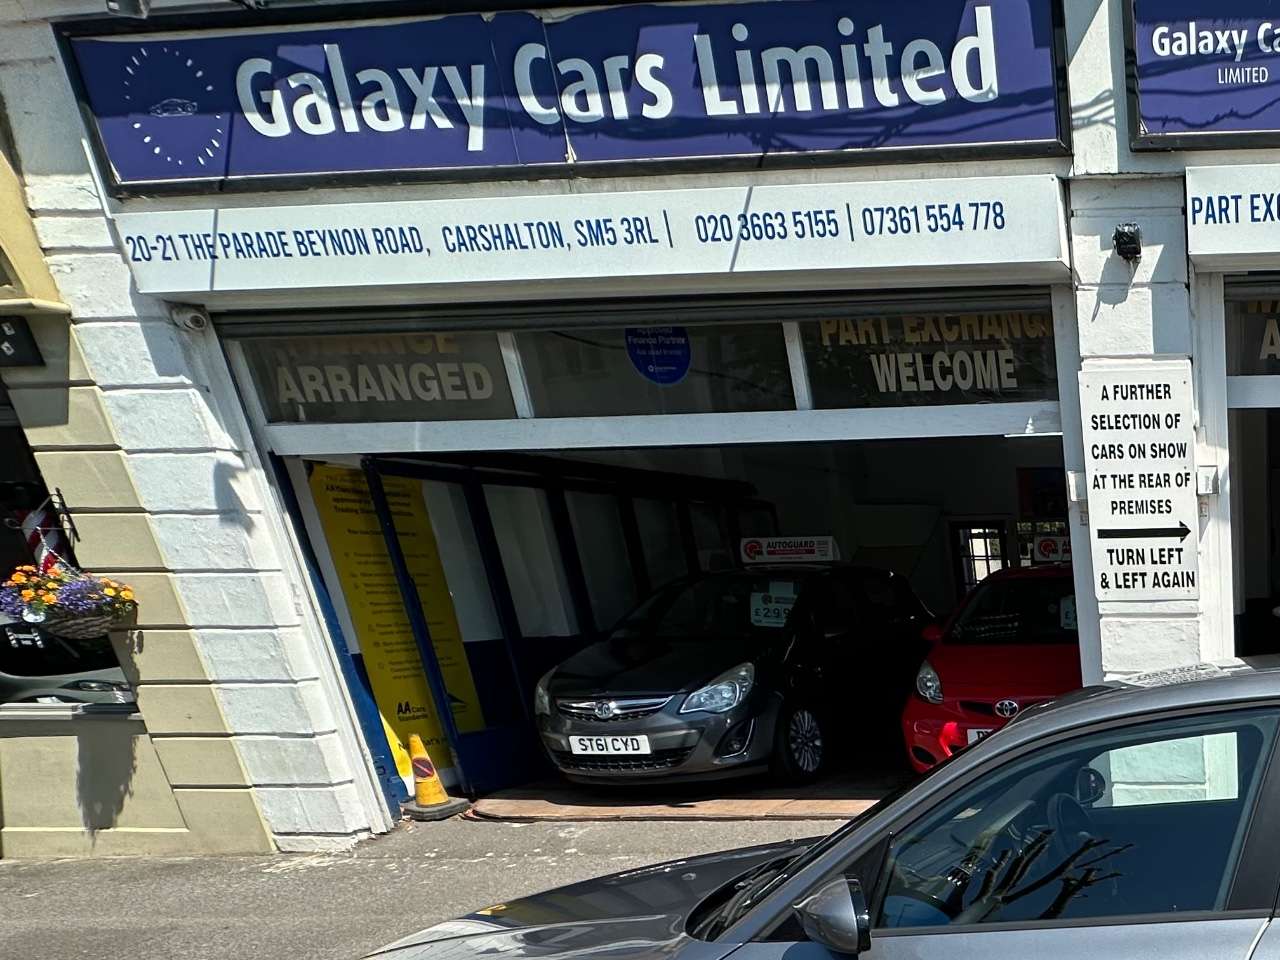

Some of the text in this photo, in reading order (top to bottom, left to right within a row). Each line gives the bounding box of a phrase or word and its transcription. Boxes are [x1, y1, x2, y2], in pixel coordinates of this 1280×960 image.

[1152, 22, 1249, 62] Galaxy
[235, 5, 999, 152] Galaxy Cars Limited
[1217, 67, 1269, 85] LIMITED
[1191, 195, 1242, 225] PART
[125, 201, 1006, 263] 20-21 THE PARADE BEYNON ROAD, CARSHALTON, SM5 3RL 020 3663 5155 07361 554 778
[902, 314, 1052, 343] EXCHANG
[869, 349, 1018, 393] WELCOME
[275, 361, 494, 404] ARRANGED
[1101, 383, 1172, 401] A FURTHER
[1091, 413, 1181, 430] SELECTION OF
[1091, 442, 1188, 460] CARS ON SHOW
[1092, 472, 1191, 490] AT THE REAR OF
[1111, 499, 1173, 516] PREMISES
[766, 540, 817, 549] AUTOGUARD
[1106, 547, 1184, 566] TURN LEFT
[1100, 571, 1196, 589] & LEFT AGAIN
[397, 701, 411, 715] AA
[578, 737, 641, 752] ST61 CYD
